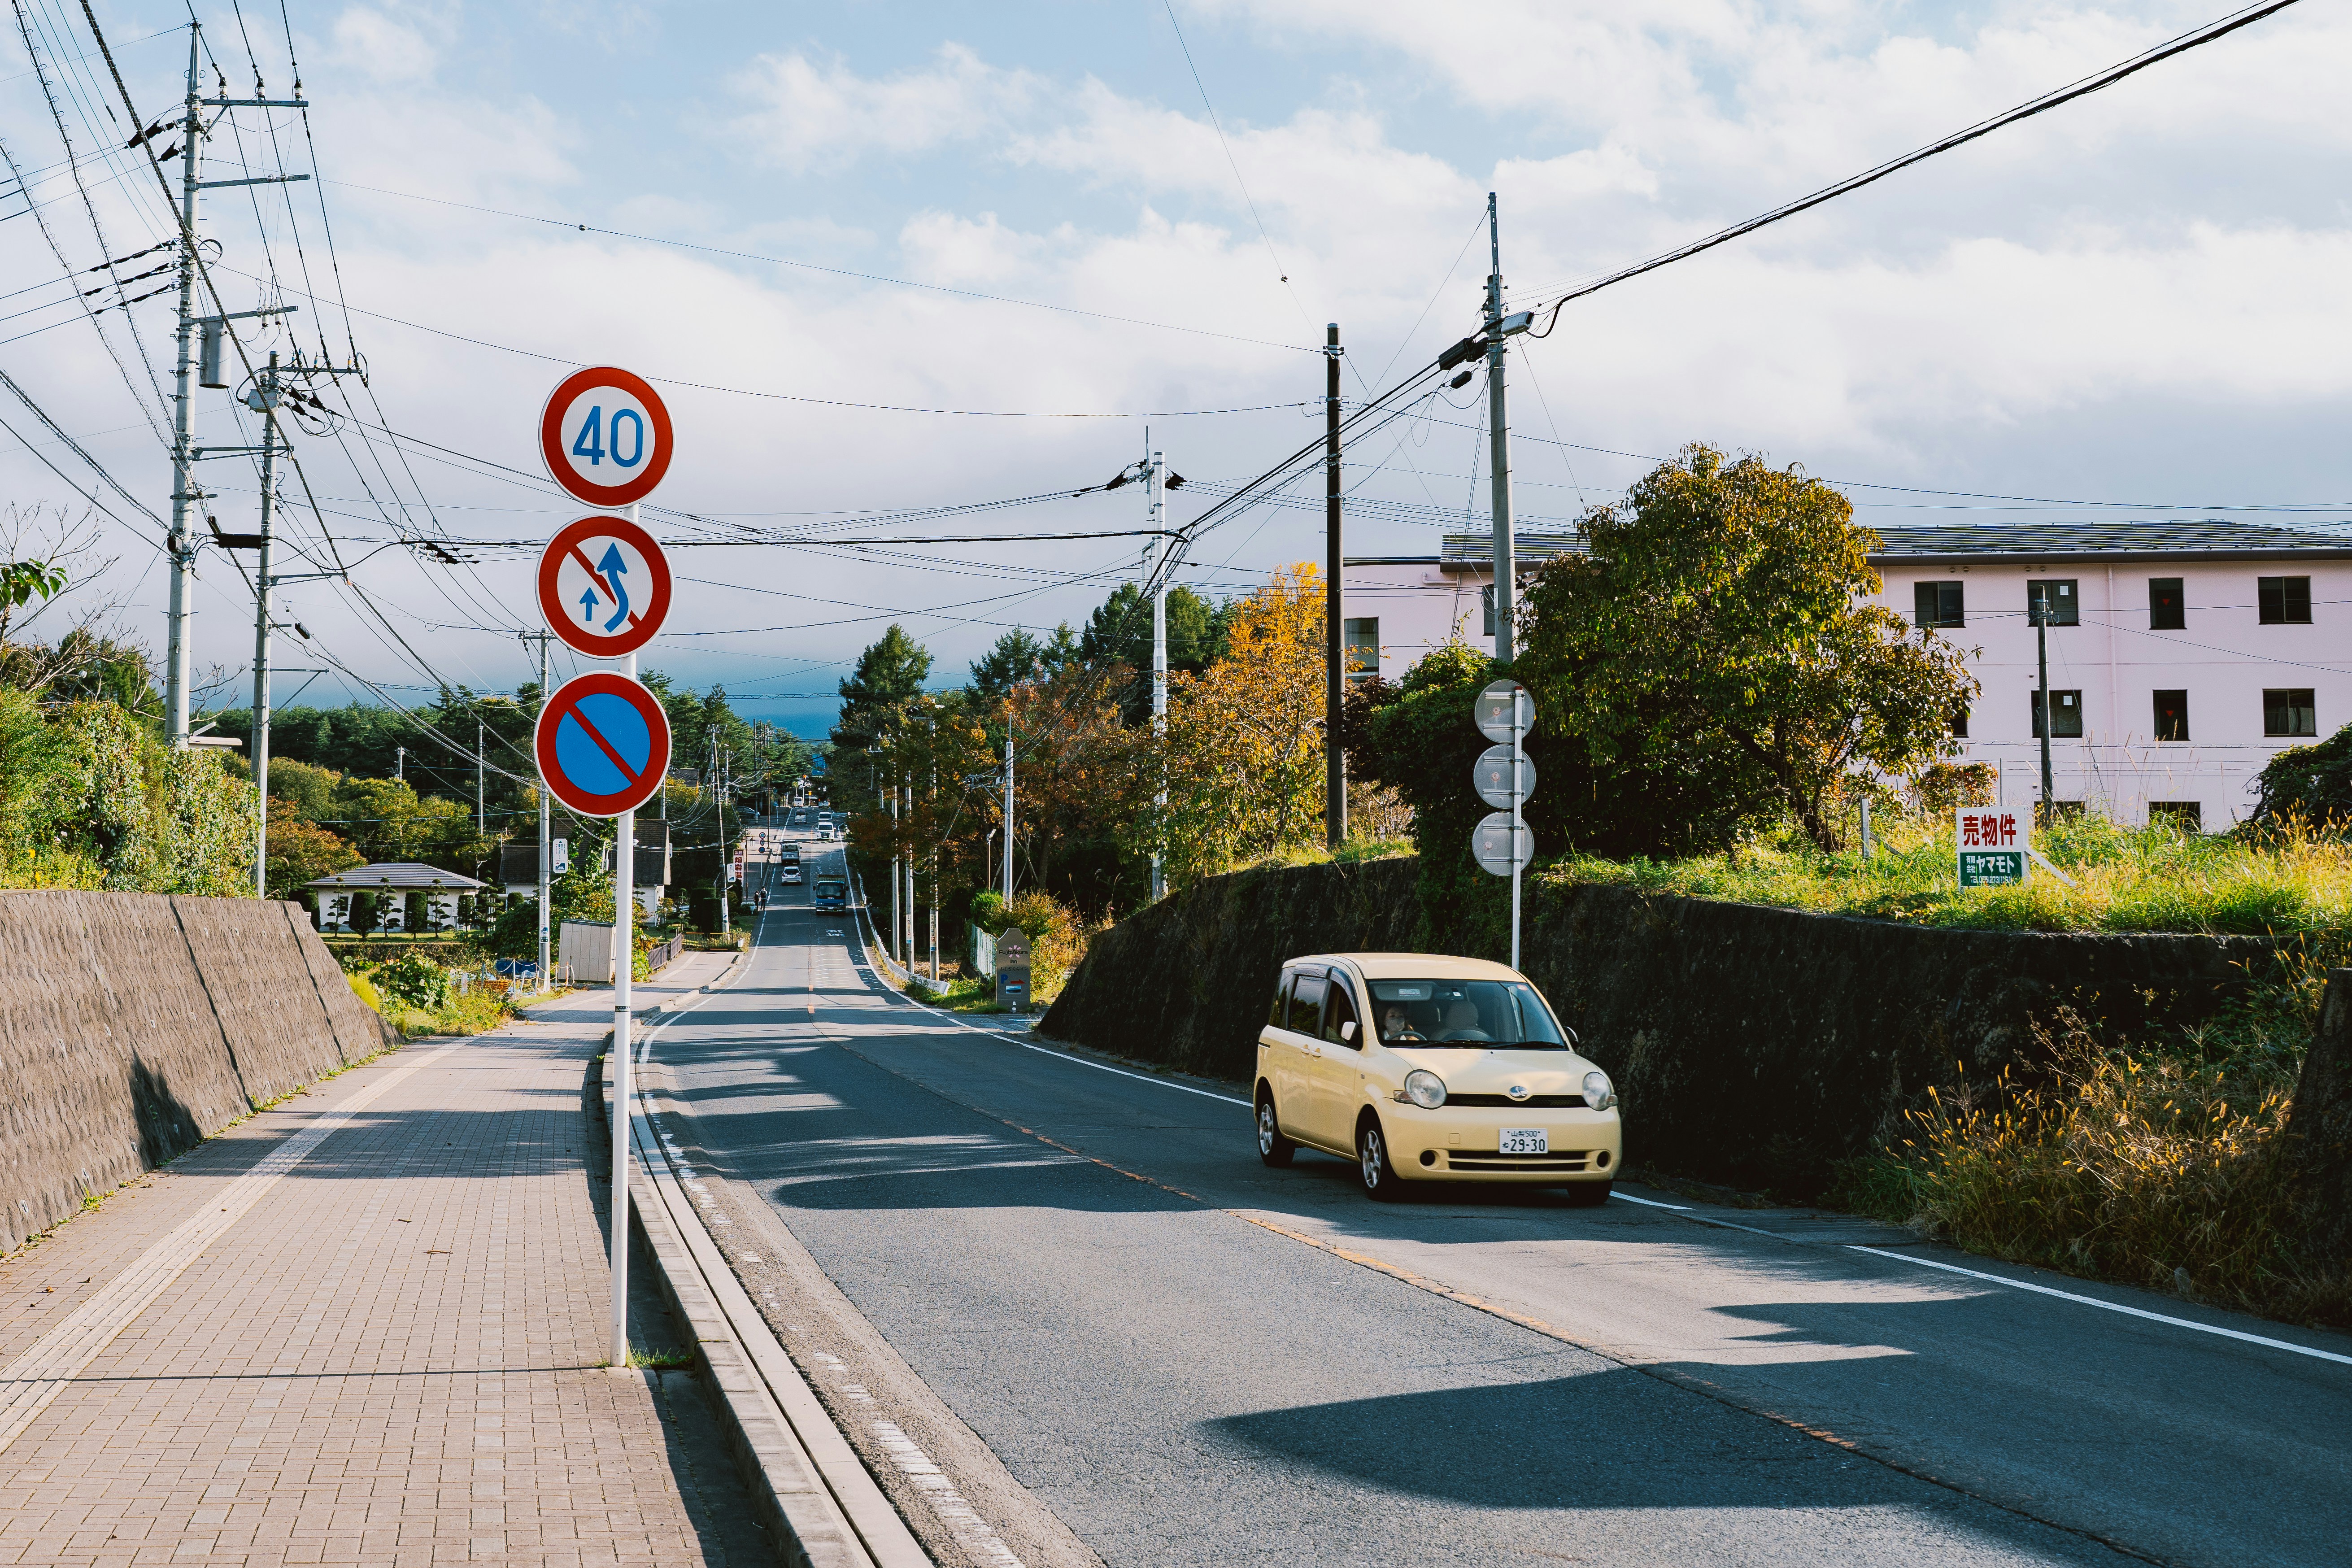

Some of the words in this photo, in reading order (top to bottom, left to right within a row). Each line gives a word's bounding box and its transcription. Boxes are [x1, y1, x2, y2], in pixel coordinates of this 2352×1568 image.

[573, 406, 643, 468] 40
[1963, 814, 2017, 846] 売物件
[1966, 855, 1976, 864] 有限
[1976, 855, 2015, 873] ヤマモト
[1966, 865, 1976, 873] 会社
[1001, 974, 1008, 984] P
[1510, 1139, 1546, 1152] 29-30
